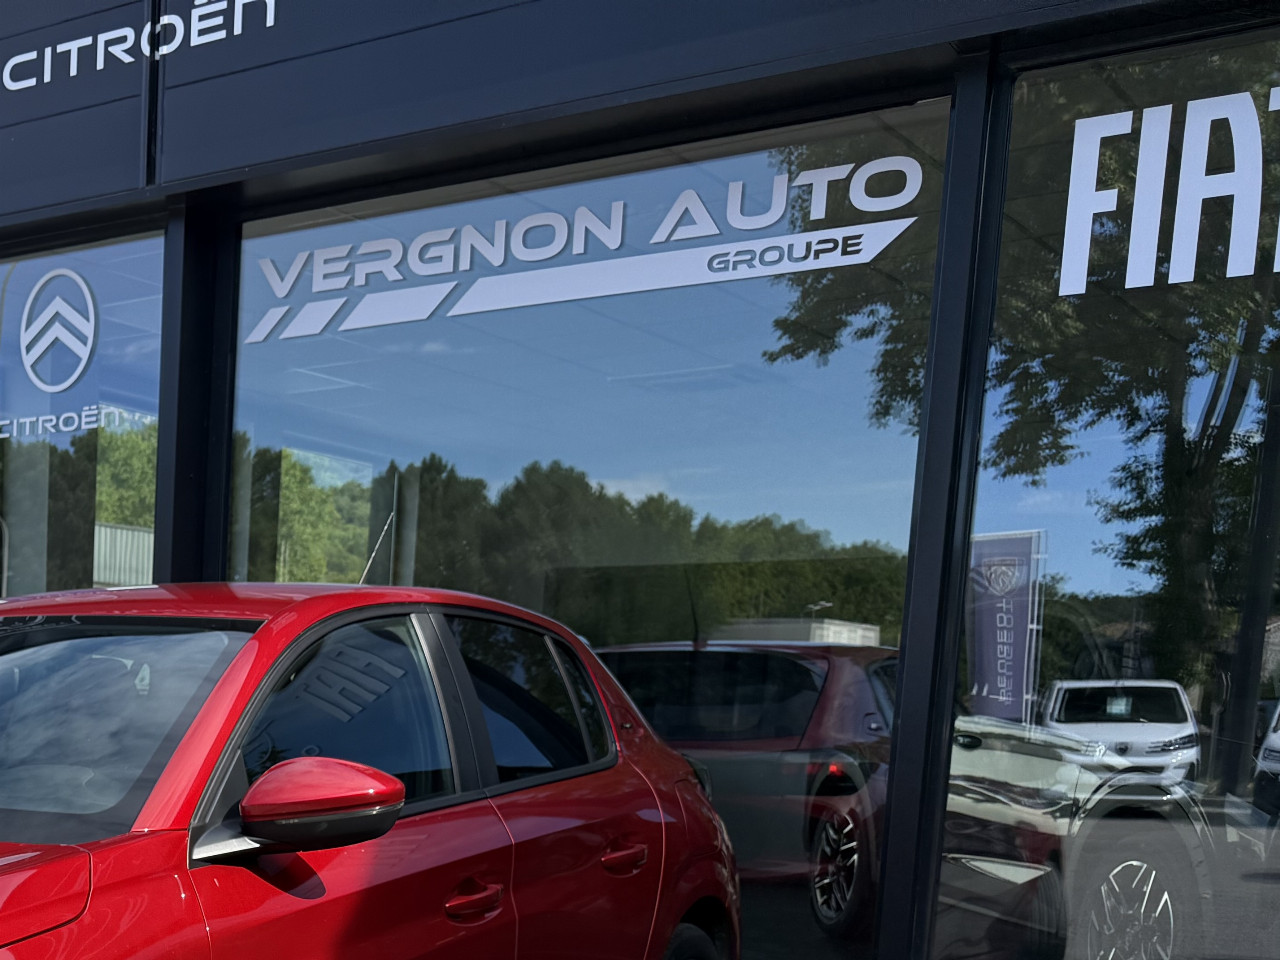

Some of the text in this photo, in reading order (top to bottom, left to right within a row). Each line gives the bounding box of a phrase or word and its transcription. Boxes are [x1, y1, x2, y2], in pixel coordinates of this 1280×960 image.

[258, 155, 924, 299] VERGNON AUTO
[706, 233, 864, 273] GROUPE
[1058, 87, 1280, 297] FIA
